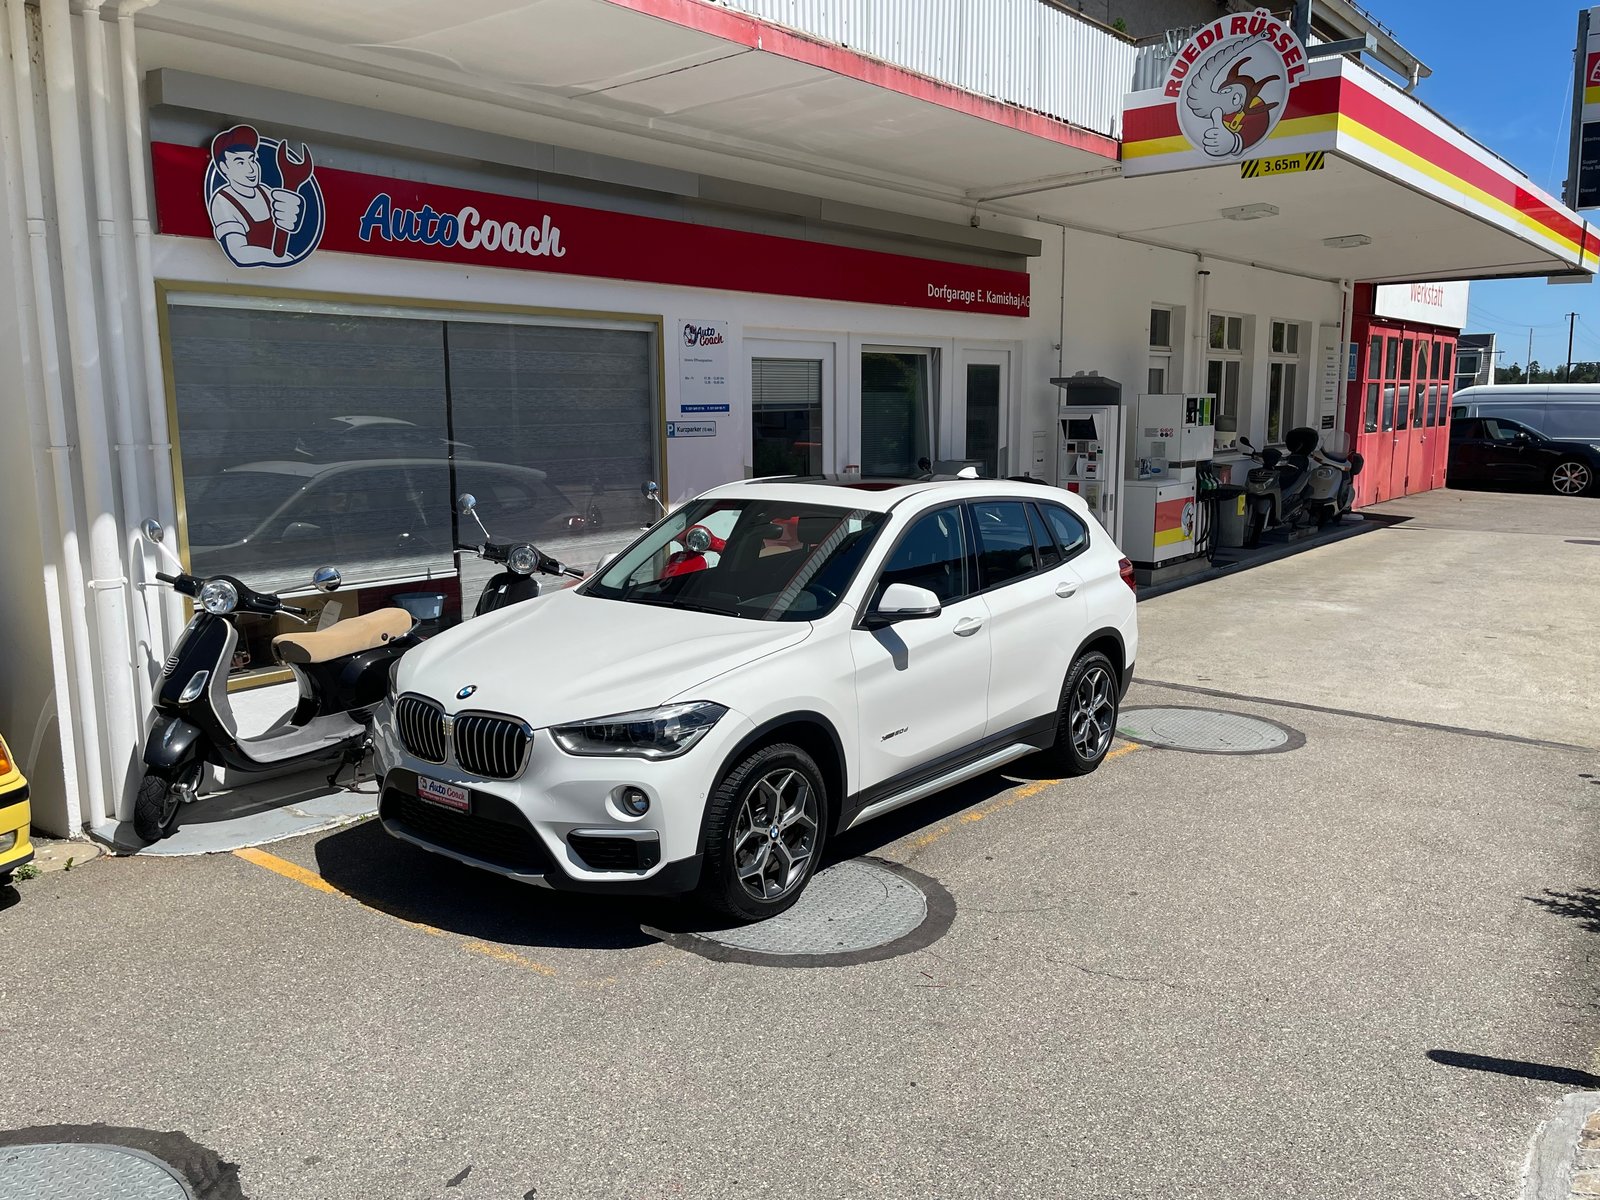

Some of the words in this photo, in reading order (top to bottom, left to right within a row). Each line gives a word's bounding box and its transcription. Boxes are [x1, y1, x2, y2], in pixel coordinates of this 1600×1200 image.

[1164, 23, 1224, 98] RUEDI
[1230, 10, 1305, 84] RÜSSEL
[1264, 160, 1300, 172] 3.65m
[927, 283, 976, 304] Dorfgarage
[977, 289, 985, 302] E.
[1410, 282, 1444, 308] Werkstatt
[697, 326, 715, 337] Auto
[700, 332, 725, 346] Coach
[428, 781, 447, 796] Auto
[447, 787, 465, 800] Coach
